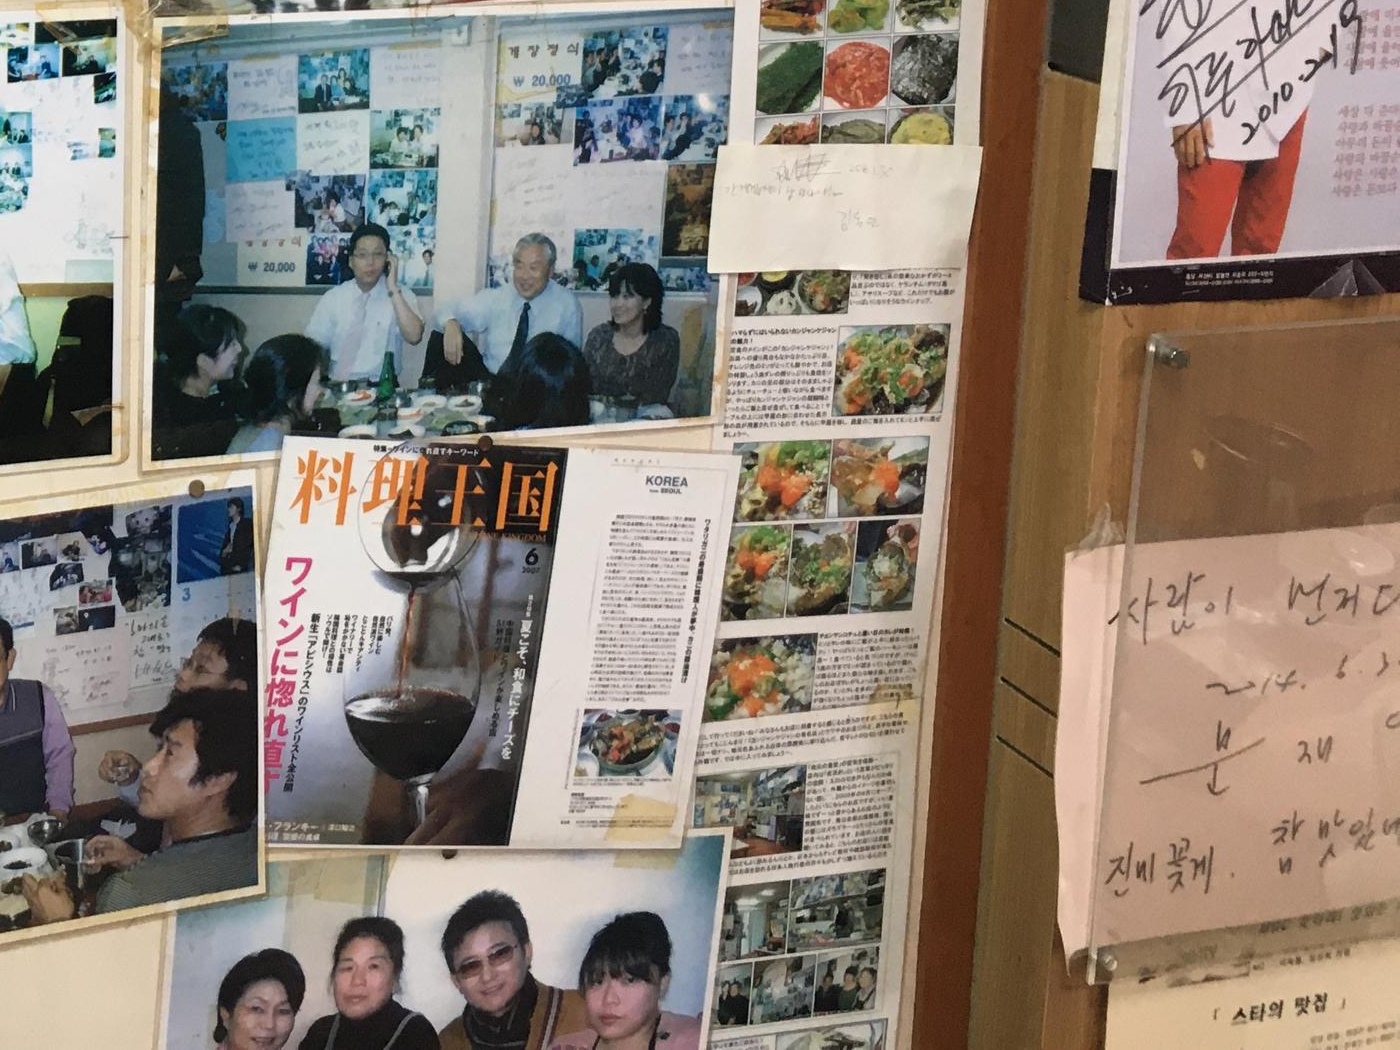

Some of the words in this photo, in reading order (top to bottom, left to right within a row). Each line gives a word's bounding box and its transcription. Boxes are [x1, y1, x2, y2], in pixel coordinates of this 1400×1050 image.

[263, 261, 296, 273] 20,000
[645, 475, 688, 487] KOREA
[289, 449, 558, 533] 料理王国
[525, 547, 539, 566] 6
[182, 587, 191, 601] 3
[1230, 999, 1283, 1024] 스타의
[1295, 992, 1328, 1016] 맛집
